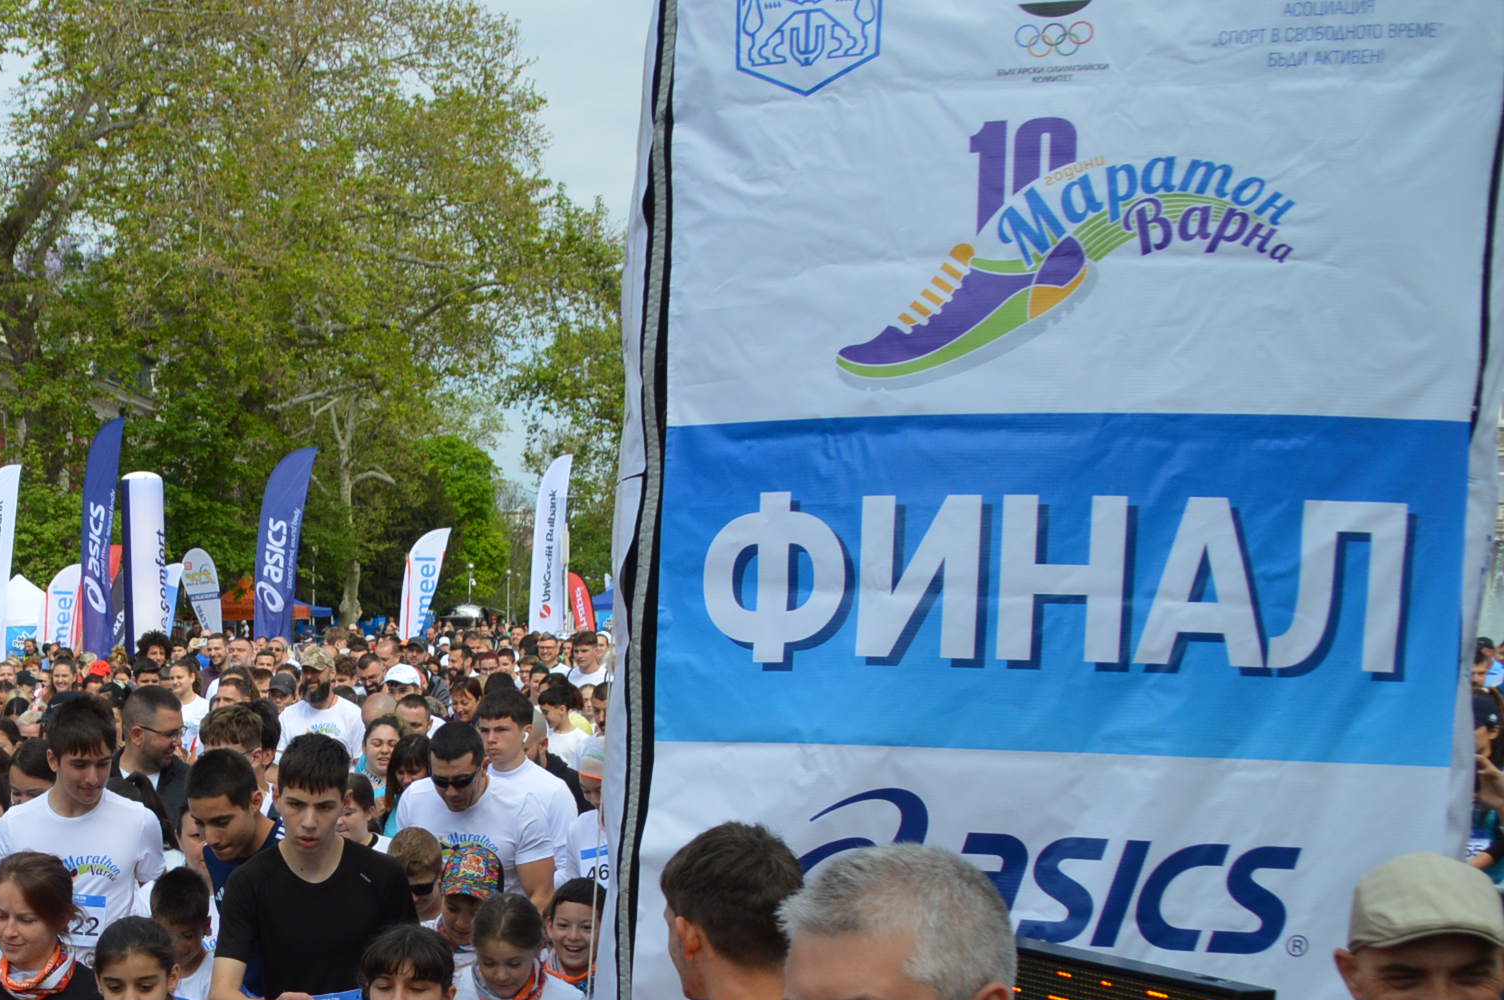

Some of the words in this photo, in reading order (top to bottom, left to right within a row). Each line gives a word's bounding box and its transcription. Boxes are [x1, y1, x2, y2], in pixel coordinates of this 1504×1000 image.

[1266, 51, 1308, 67] БЪДИ
[1271, 27, 1280, 43] В
[1284, 24, 1383, 42] СВОБОДНОТО
[969, 117, 1077, 236] 10
[998, 156, 1295, 268] Маратон
[1123, 197, 1293, 263] Варна
[702, 490, 1414, 680] ФИНАЛ
